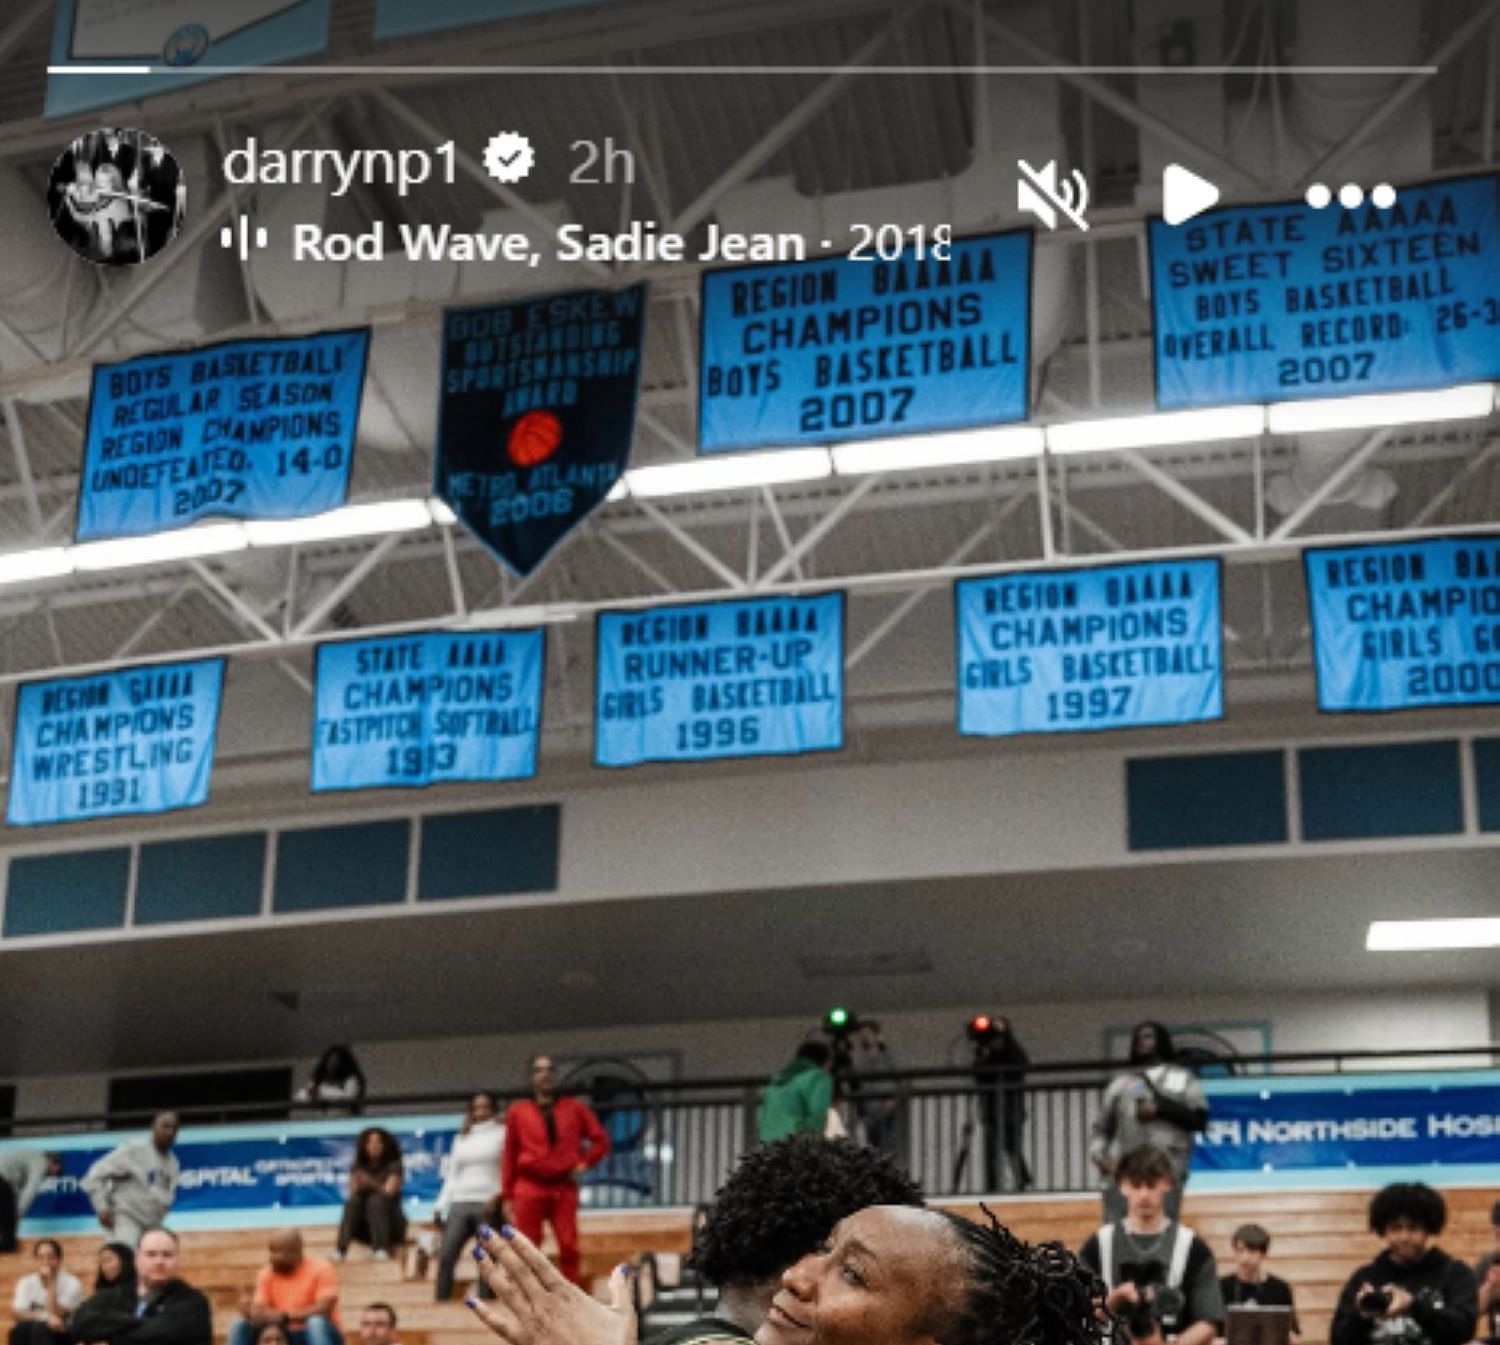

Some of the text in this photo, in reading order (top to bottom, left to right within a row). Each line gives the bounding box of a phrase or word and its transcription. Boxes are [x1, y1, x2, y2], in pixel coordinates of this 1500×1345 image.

[1187, 216, 1304, 250] STATE
[1170, 232, 1480, 288] SWEET SIXTEEN
[733, 271, 835, 316] REGION
[1197, 268, 1453, 320] BOYS BASKETBALL
[745, 294, 980, 352] CHAMPIONS
[1164, 325, 1273, 359] OVERALL
[111, 366, 170, 398] BOYS
[708, 333, 1016, 396] BOYS BASKETBALL
[1281, 354, 1372, 384] 2007
[114, 379, 332, 427] REGULAR SEASON
[802, 389, 916, 431] 2007
[103, 412, 340, 459] REGION CHAMPIONS
[175, 480, 244, 516] 2007
[491, 489, 574, 524] 2006
[1328, 554, 1423, 587] REGION
[985, 583, 1075, 613] REGION
[623, 615, 706, 645] REGION
[992, 608, 1186, 649] CHAMPIONS
[1364, 628, 1440, 660] GIRLS
[358, 643, 422, 673] STATE
[626, 640, 811, 682] RUNNER-UP
[967, 645, 1214, 688] GIRLS BASKETBALL
[345, 674, 511, 708] CHAMPIONS
[604, 674, 834, 718] GIRLS BASKETBALL
[1050, 687, 1130, 721] 1997
[39, 705, 192, 747] CHAMPIONS
[678, 718, 758, 750] 1996
[35, 738, 192, 780] WRESTLING
[1247, 1117, 1417, 1143] NORTHSIDE
